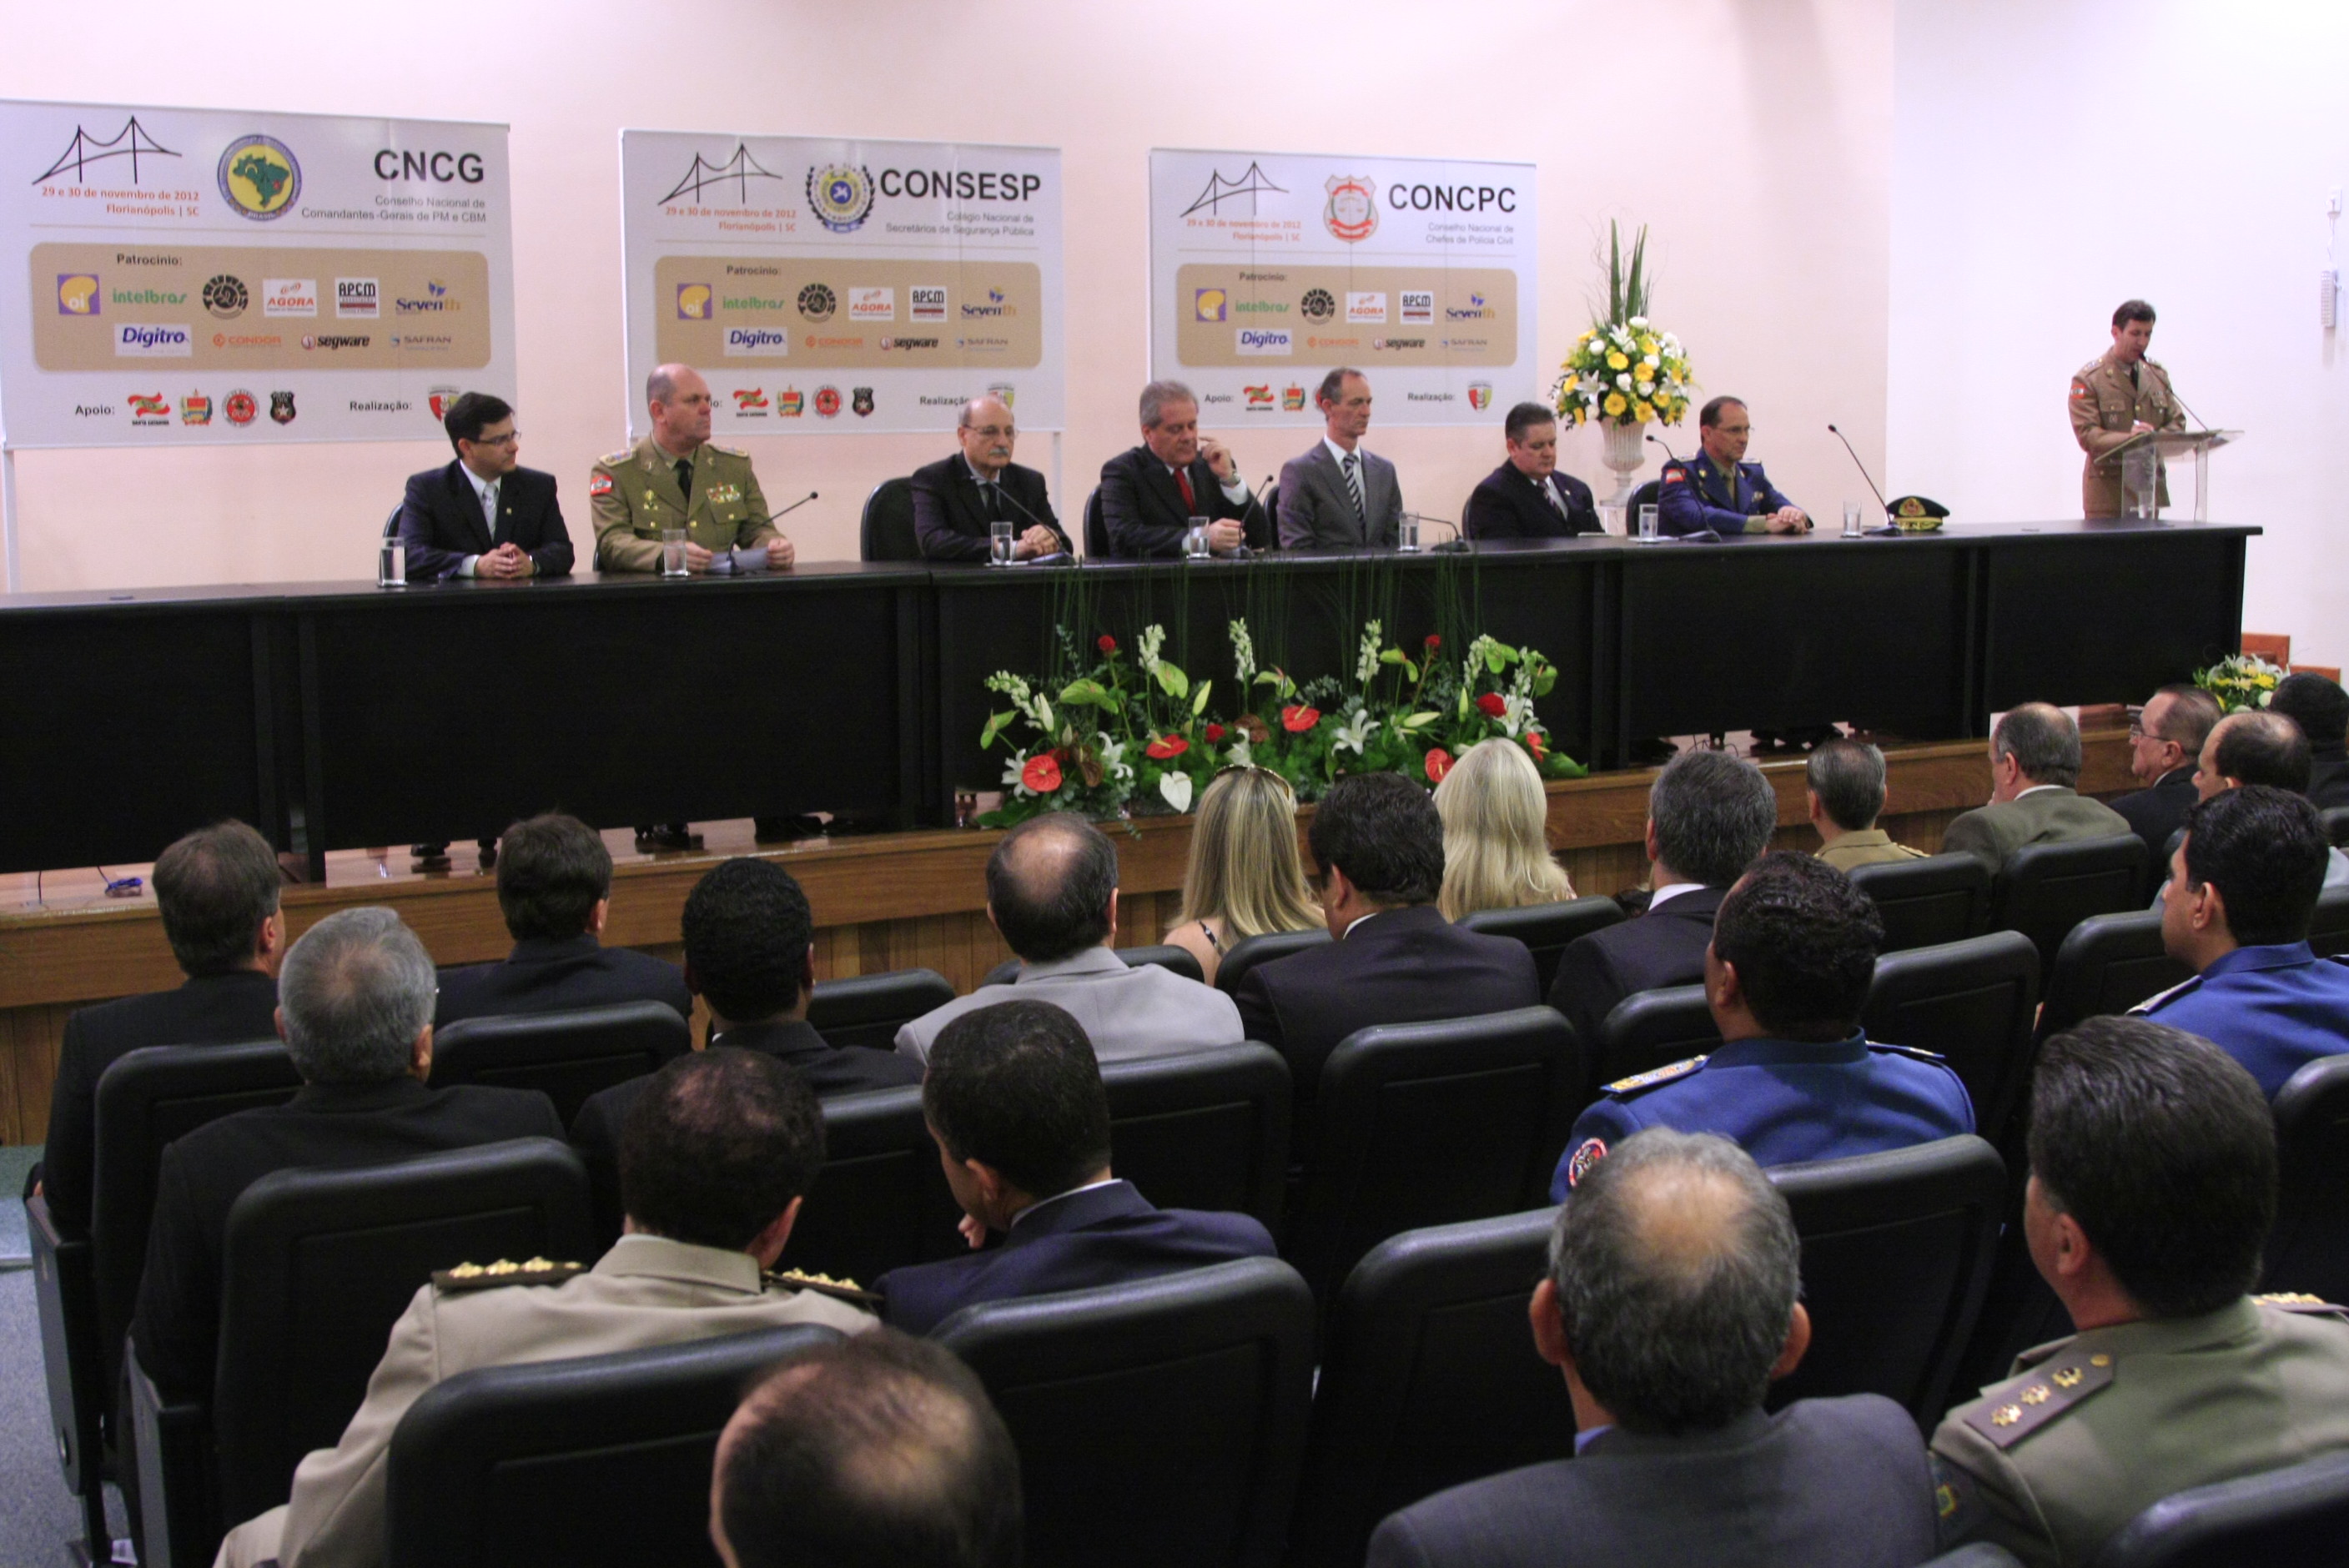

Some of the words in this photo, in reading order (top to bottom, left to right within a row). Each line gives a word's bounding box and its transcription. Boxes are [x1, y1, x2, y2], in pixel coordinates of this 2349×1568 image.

[374, 149, 484, 183] CNCG
[880, 169, 1040, 201] CONSESP
[43, 187, 55, 197] 29
[68, 188, 81, 198] 30
[84, 188, 97, 198] de
[101, 188, 155, 199] novembro
[158, 190, 171, 200] de
[174, 191, 199, 201] 2012
[1389, 183, 1516, 213] CONCPC
[375, 195, 424, 207] Conselho
[426, 197, 470, 208] Nacional
[472, 199, 485, 209] de
[107, 204, 175, 216] Florianópolis
[187, 207, 199, 216] SC
[666, 207, 677, 216] 29
[688, 208, 697, 216] 30
[701, 208, 711, 216] de
[714, 209, 759, 218] novembro
[762, 209, 772, 218] de
[776, 209, 796, 218] 2012
[417, 211, 429, 221] de
[433, 212, 449, 222] PM
[461, 212, 486, 223] CBM
[947, 211, 980, 222] Colégio
[983, 214, 1020, 223] Nacional
[1023, 214, 1034, 223] de
[1217, 219, 1226, 227] de
[1229, 219, 1269, 228] novembro
[719, 222, 776, 232] Florianópolis
[786, 224, 796, 232] SC
[886, 223, 937, 234] Secretários
[939, 224, 950, 234] de
[953, 225, 999, 237] Segurança
[1003, 225, 1034, 236] Pública
[1428, 222, 1466, 232] Conselho
[1468, 224, 1501, 232] Nacional
[1426, 234, 1454, 244] Chefes
[1456, 235, 1466, 244] de
[1497, 236, 1513, 244] Civil
[339, 282, 376, 296] APCM
[68, 293, 84, 309] oi
[113, 288, 188, 304] intelbras
[268, 297, 314, 307] AGORA
[723, 295, 784, 309] intelbras
[913, 290, 944, 303] APCM
[1402, 295, 1431, 307] APCM
[396, 298, 460, 311] Seventh
[686, 299, 700, 314] oi
[962, 304, 1017, 316] Seventh
[1235, 300, 1290, 313] intelbras
[1446, 308, 1495, 319] Seventh
[123, 327, 185, 348] Dígitro
[229, 335, 281, 344] CONDOR
[318, 335, 370, 349] segware
[730, 329, 782, 348] Dígitro
[893, 338, 938, 350] segware
[1241, 331, 1288, 348] Dígitro
[1386, 338, 1426, 350] segware
[1205, 394, 1235, 404] Apoio:
[1408, 392, 1456, 402] Realização:
[75, 405, 115, 417] Apoio:
[350, 400, 412, 413] Realização:
